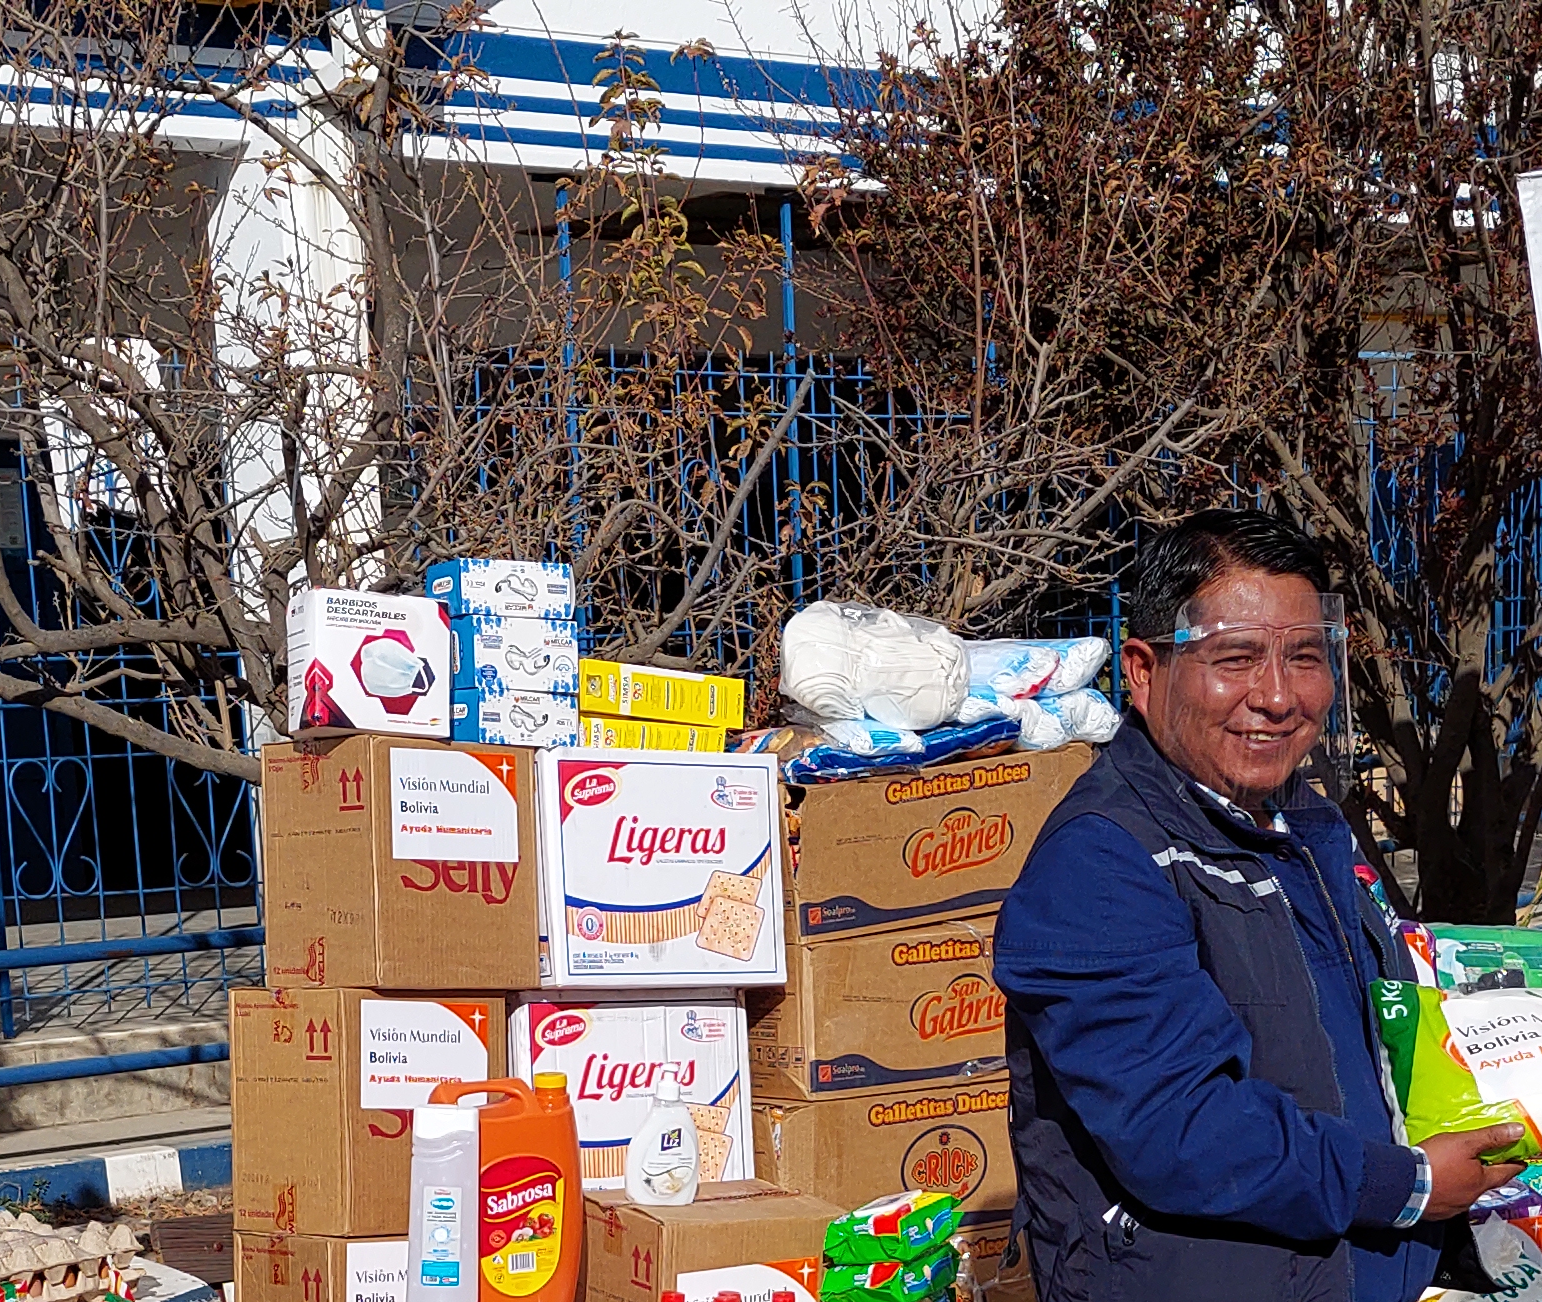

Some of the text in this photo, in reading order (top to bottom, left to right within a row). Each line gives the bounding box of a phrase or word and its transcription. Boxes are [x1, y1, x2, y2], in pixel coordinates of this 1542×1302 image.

[327, 597, 377, 608] BARBIJOS
[327, 607, 407, 621] DESCARTABLES
[400, 776, 490, 794] Visión Mundial
[573, 783, 615, 801] Suprema
[585, 778, 598, 788] La
[885, 762, 1030, 804] Galletitas Dulces
[400, 801, 439, 814] Bolivia
[400, 824, 493, 836] Ayuda Humanitaria
[943, 814, 972, 836] San
[607, 816, 726, 866] Ligeras
[910, 813, 1008, 879] Gabriel
[892, 939, 980, 965] Galletitas
[948, 980, 980, 999] San
[1380, 979, 1407, 1020] 5 Kg
[555, 1018, 566, 1029] La
[918, 987, 1007, 1041] Gabrie
[369, 1027, 461, 1044] Visión Mundial
[543, 1023, 585, 1041] Suprema
[1455, 1013, 1528, 1039] Visión
[1465, 1029, 1541, 1056] Bolivia
[369, 1051, 408, 1064] Bolivia
[1479, 1050, 1536, 1071] Ayuda
[369, 1074, 401, 1084] Ayuda
[868, 1100, 954, 1126] Galletitas
[911, 1148, 979, 1188] CRICK
[486, 1183, 553, 1215] Sabrosa
[356, 1269, 395, 1284] Visión
